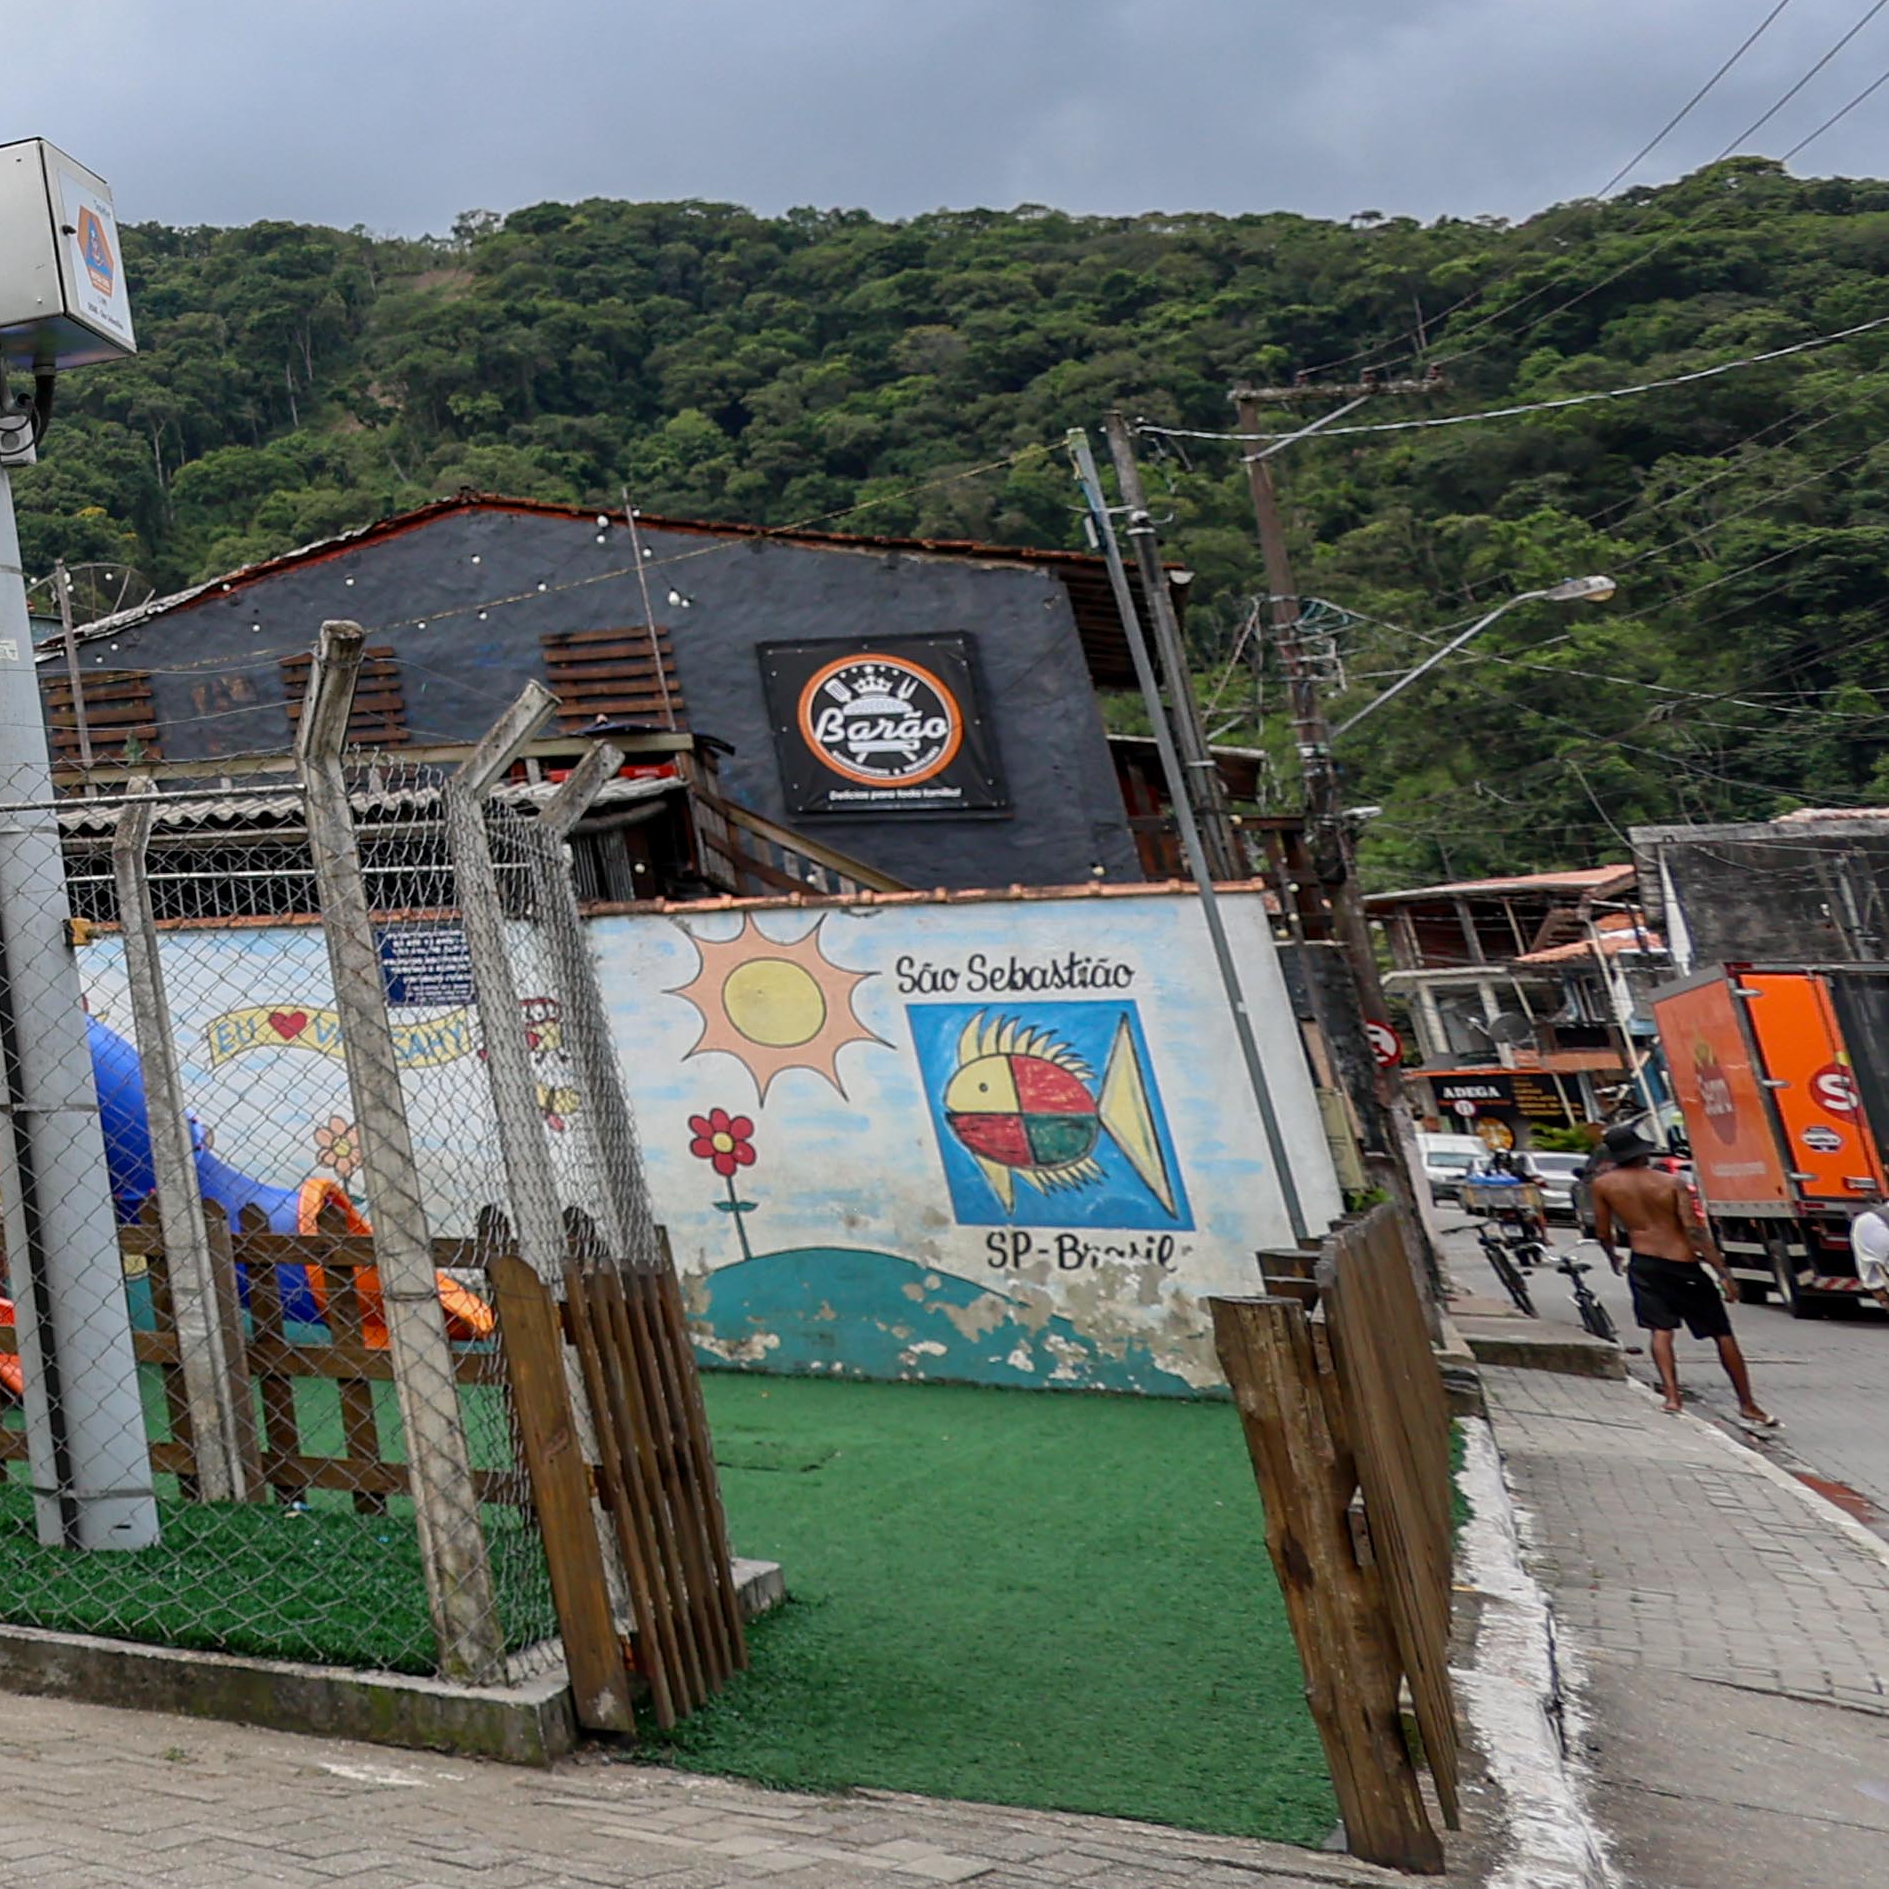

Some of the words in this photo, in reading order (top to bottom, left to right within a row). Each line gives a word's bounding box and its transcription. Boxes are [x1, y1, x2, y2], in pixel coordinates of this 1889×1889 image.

[814, 707, 948, 743] Barão
[896, 956, 960, 994] São
[967, 951, 1135, 992] Sebastião
[217, 1016, 255, 1054] EU
[1443, 1085, 1501, 1099] ADEGA
